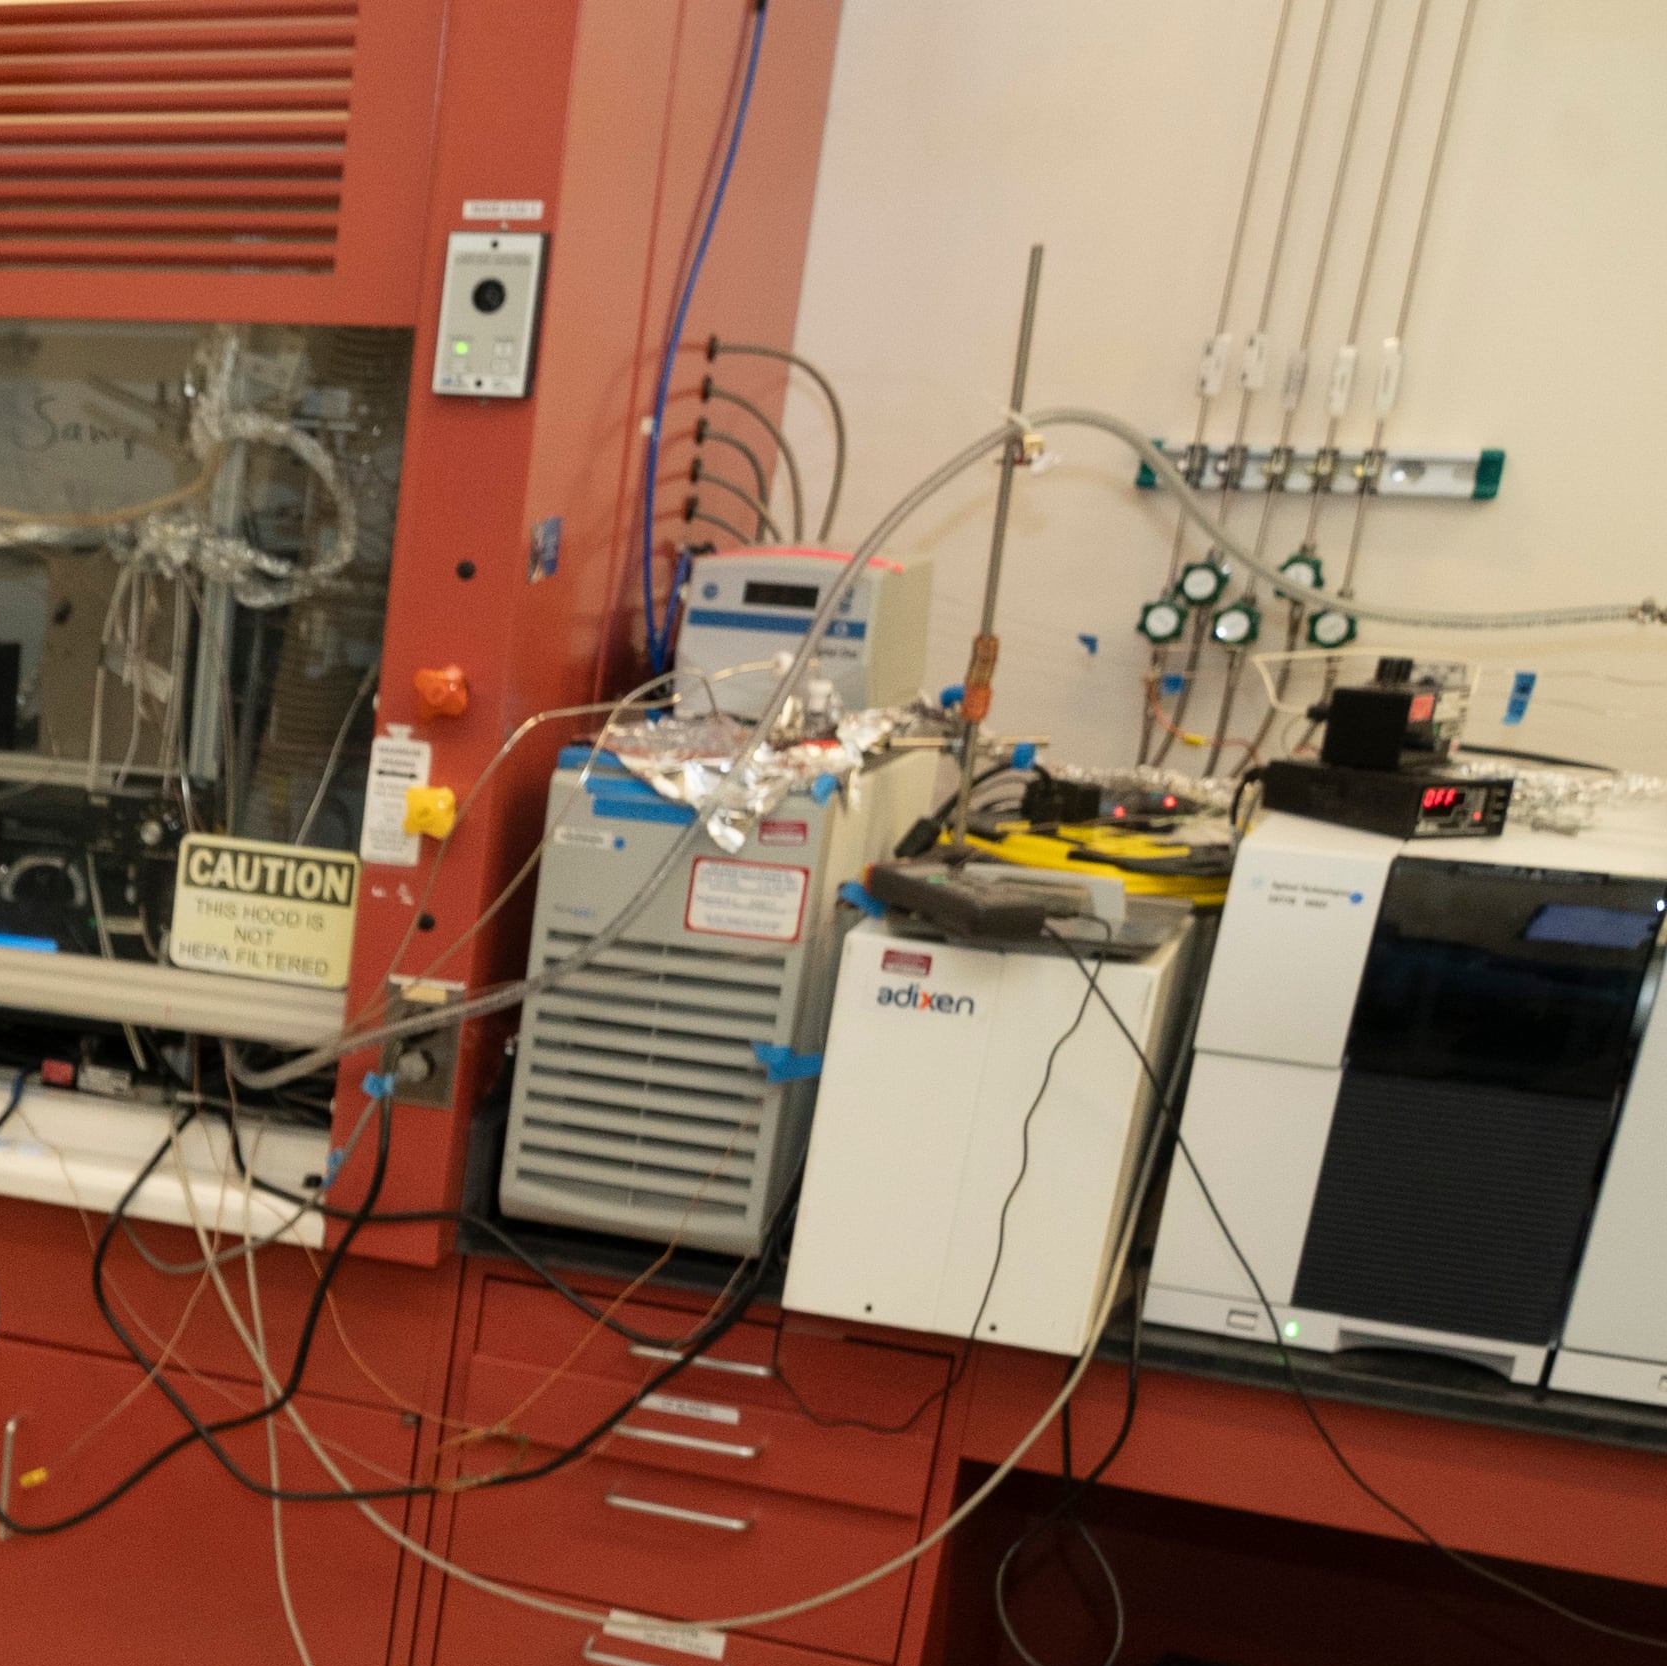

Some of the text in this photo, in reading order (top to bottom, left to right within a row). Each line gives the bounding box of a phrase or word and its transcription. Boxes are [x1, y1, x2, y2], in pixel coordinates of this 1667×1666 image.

[189, 849, 350, 903] CAUTION
[196, 897, 324, 931] THIS HOOD IS
[234, 926, 275, 945] NOT
[179, 940, 329, 977] HEPA FILTERED
[877, 983, 974, 1016] adixen
